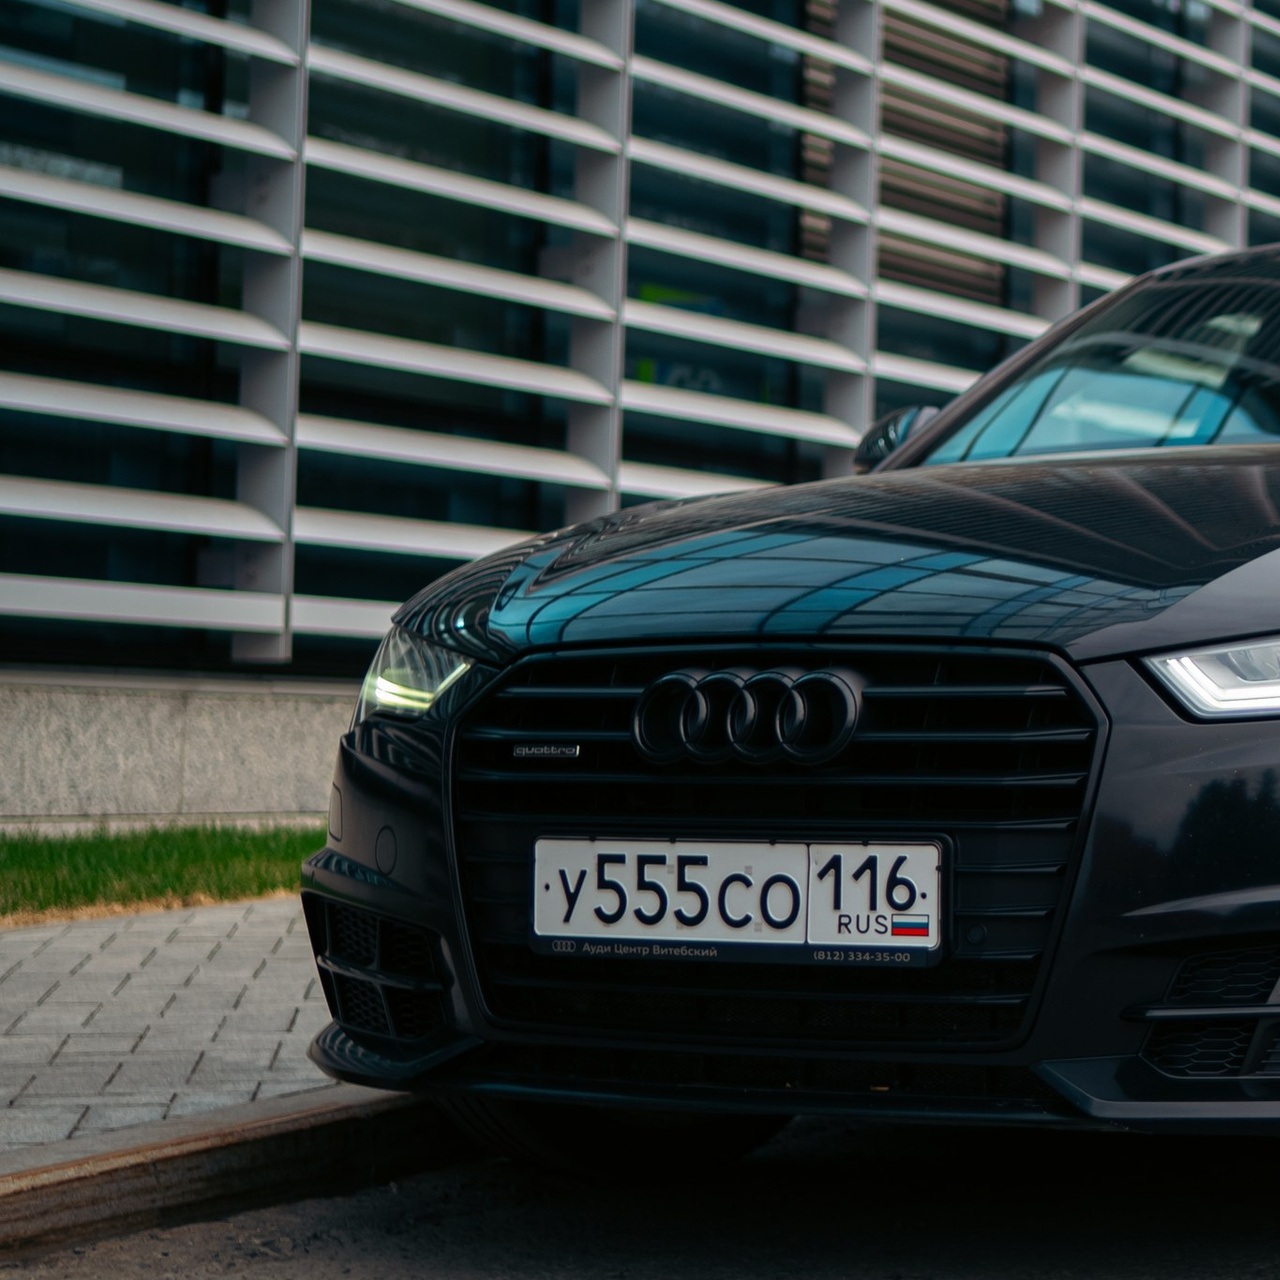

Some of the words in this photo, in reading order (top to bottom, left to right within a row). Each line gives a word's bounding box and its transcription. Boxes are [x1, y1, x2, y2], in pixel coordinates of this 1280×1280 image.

[516, 746, 576, 757] quattro
[817, 854, 917, 911] 116
[838, 914, 888, 934] RUS
[582, 942, 611, 955] Ауди
[614, 943, 650, 956] Центр
[653, 944, 718, 957] Витебский
[813, 950, 845, 961] (812)
[848, 951, 911, 962] 334-35-00
